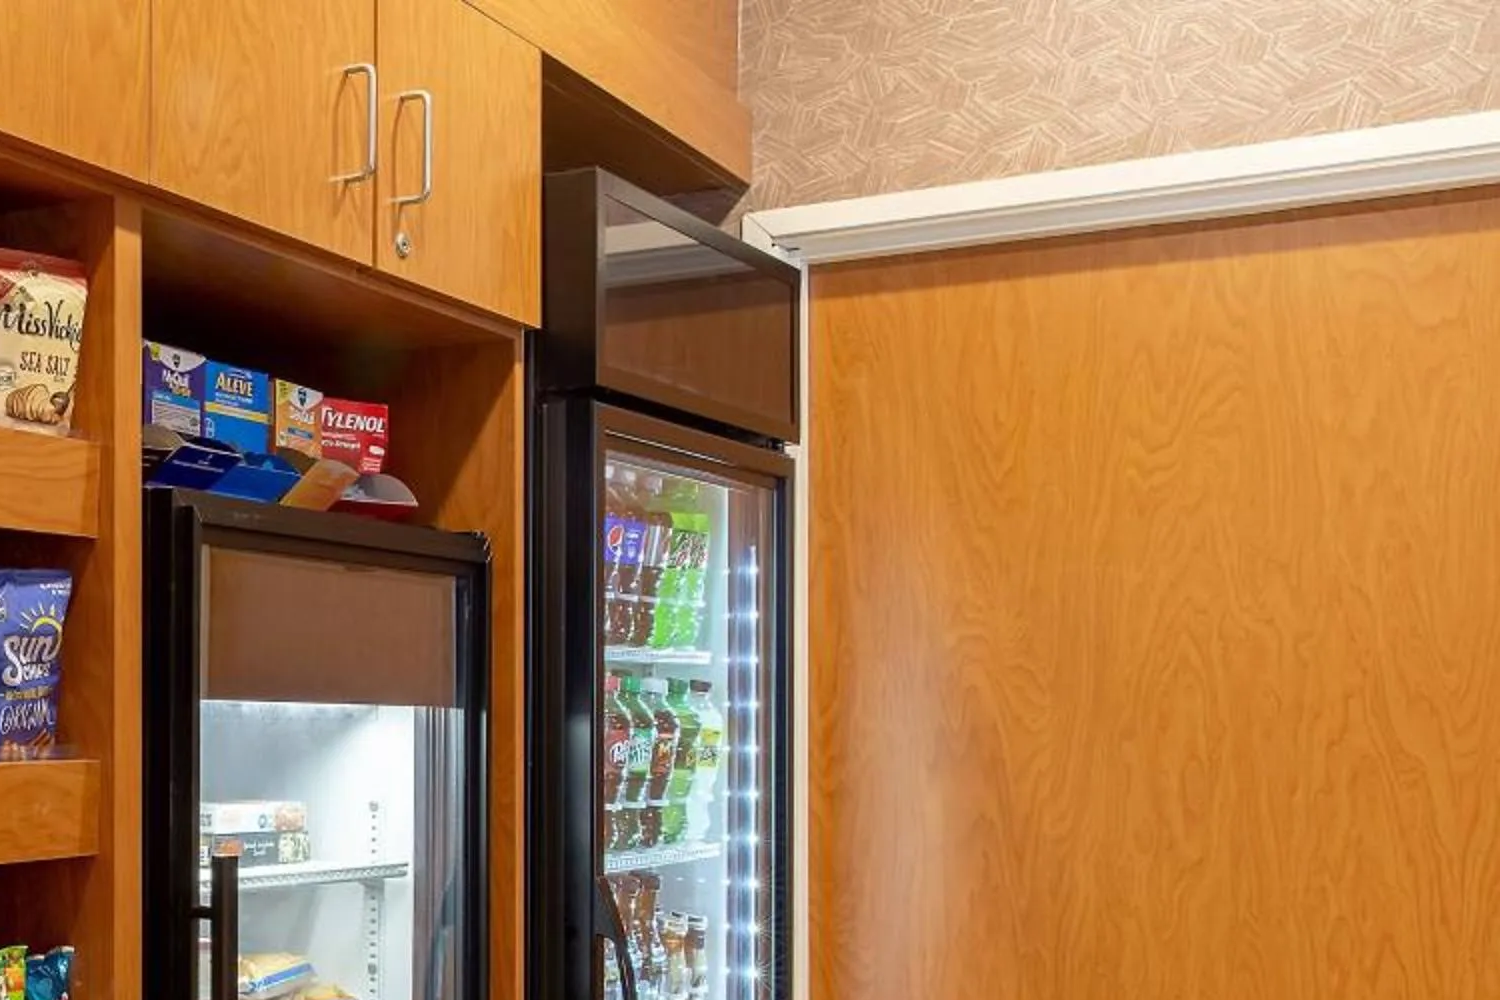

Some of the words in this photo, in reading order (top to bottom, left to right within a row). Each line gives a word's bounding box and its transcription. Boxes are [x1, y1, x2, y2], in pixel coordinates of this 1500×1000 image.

[20, 352, 42, 373] SEA
[46, 354, 71, 376] SALT
[215, 372, 253, 397] ALEVE
[321, 406, 385, 433] TYLENOL
[2, 636, 58, 687] Sun
